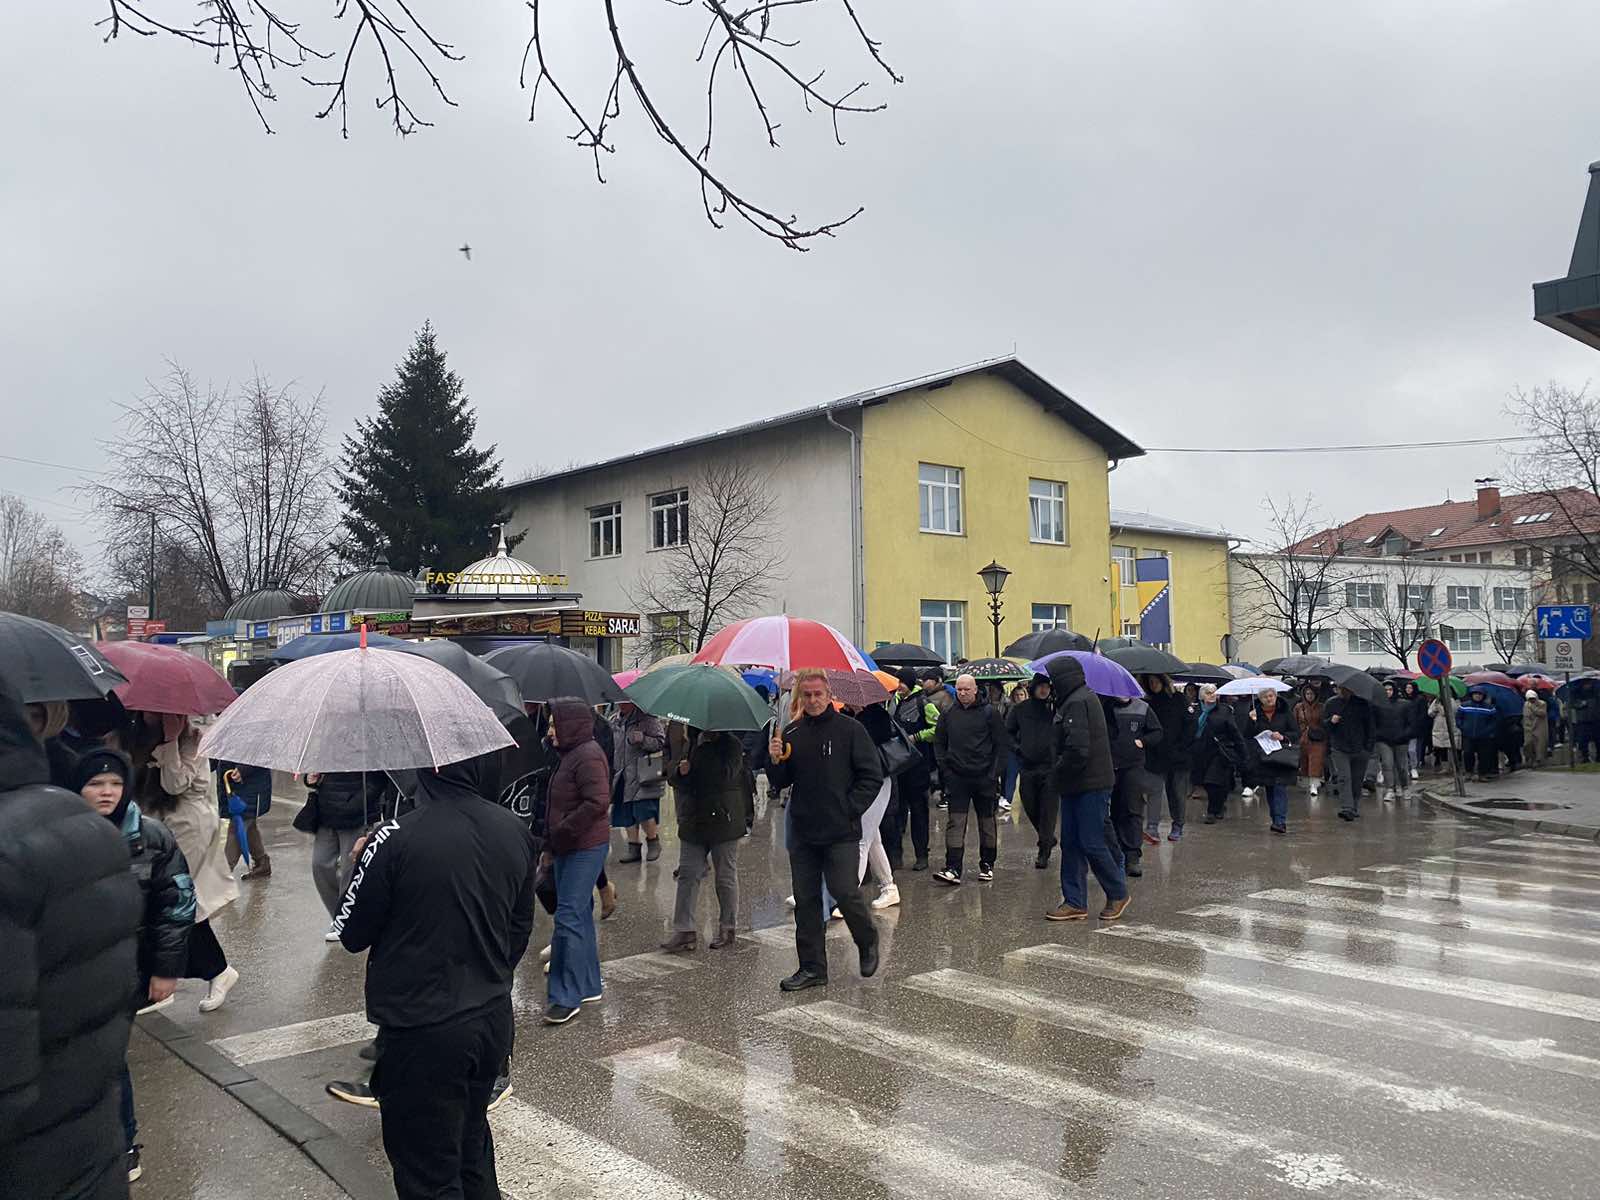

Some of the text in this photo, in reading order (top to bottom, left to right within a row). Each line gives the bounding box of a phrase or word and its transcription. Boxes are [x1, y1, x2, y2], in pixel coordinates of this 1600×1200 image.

[426, 572, 464, 585] FAST
[470, 573, 515, 585] FOOD
[584, 611, 603, 622] PIZZA
[584, 625, 607, 636] KEBAB
[608, 618, 640, 634] SARAJ
[361, 819, 401, 868] NIKE
